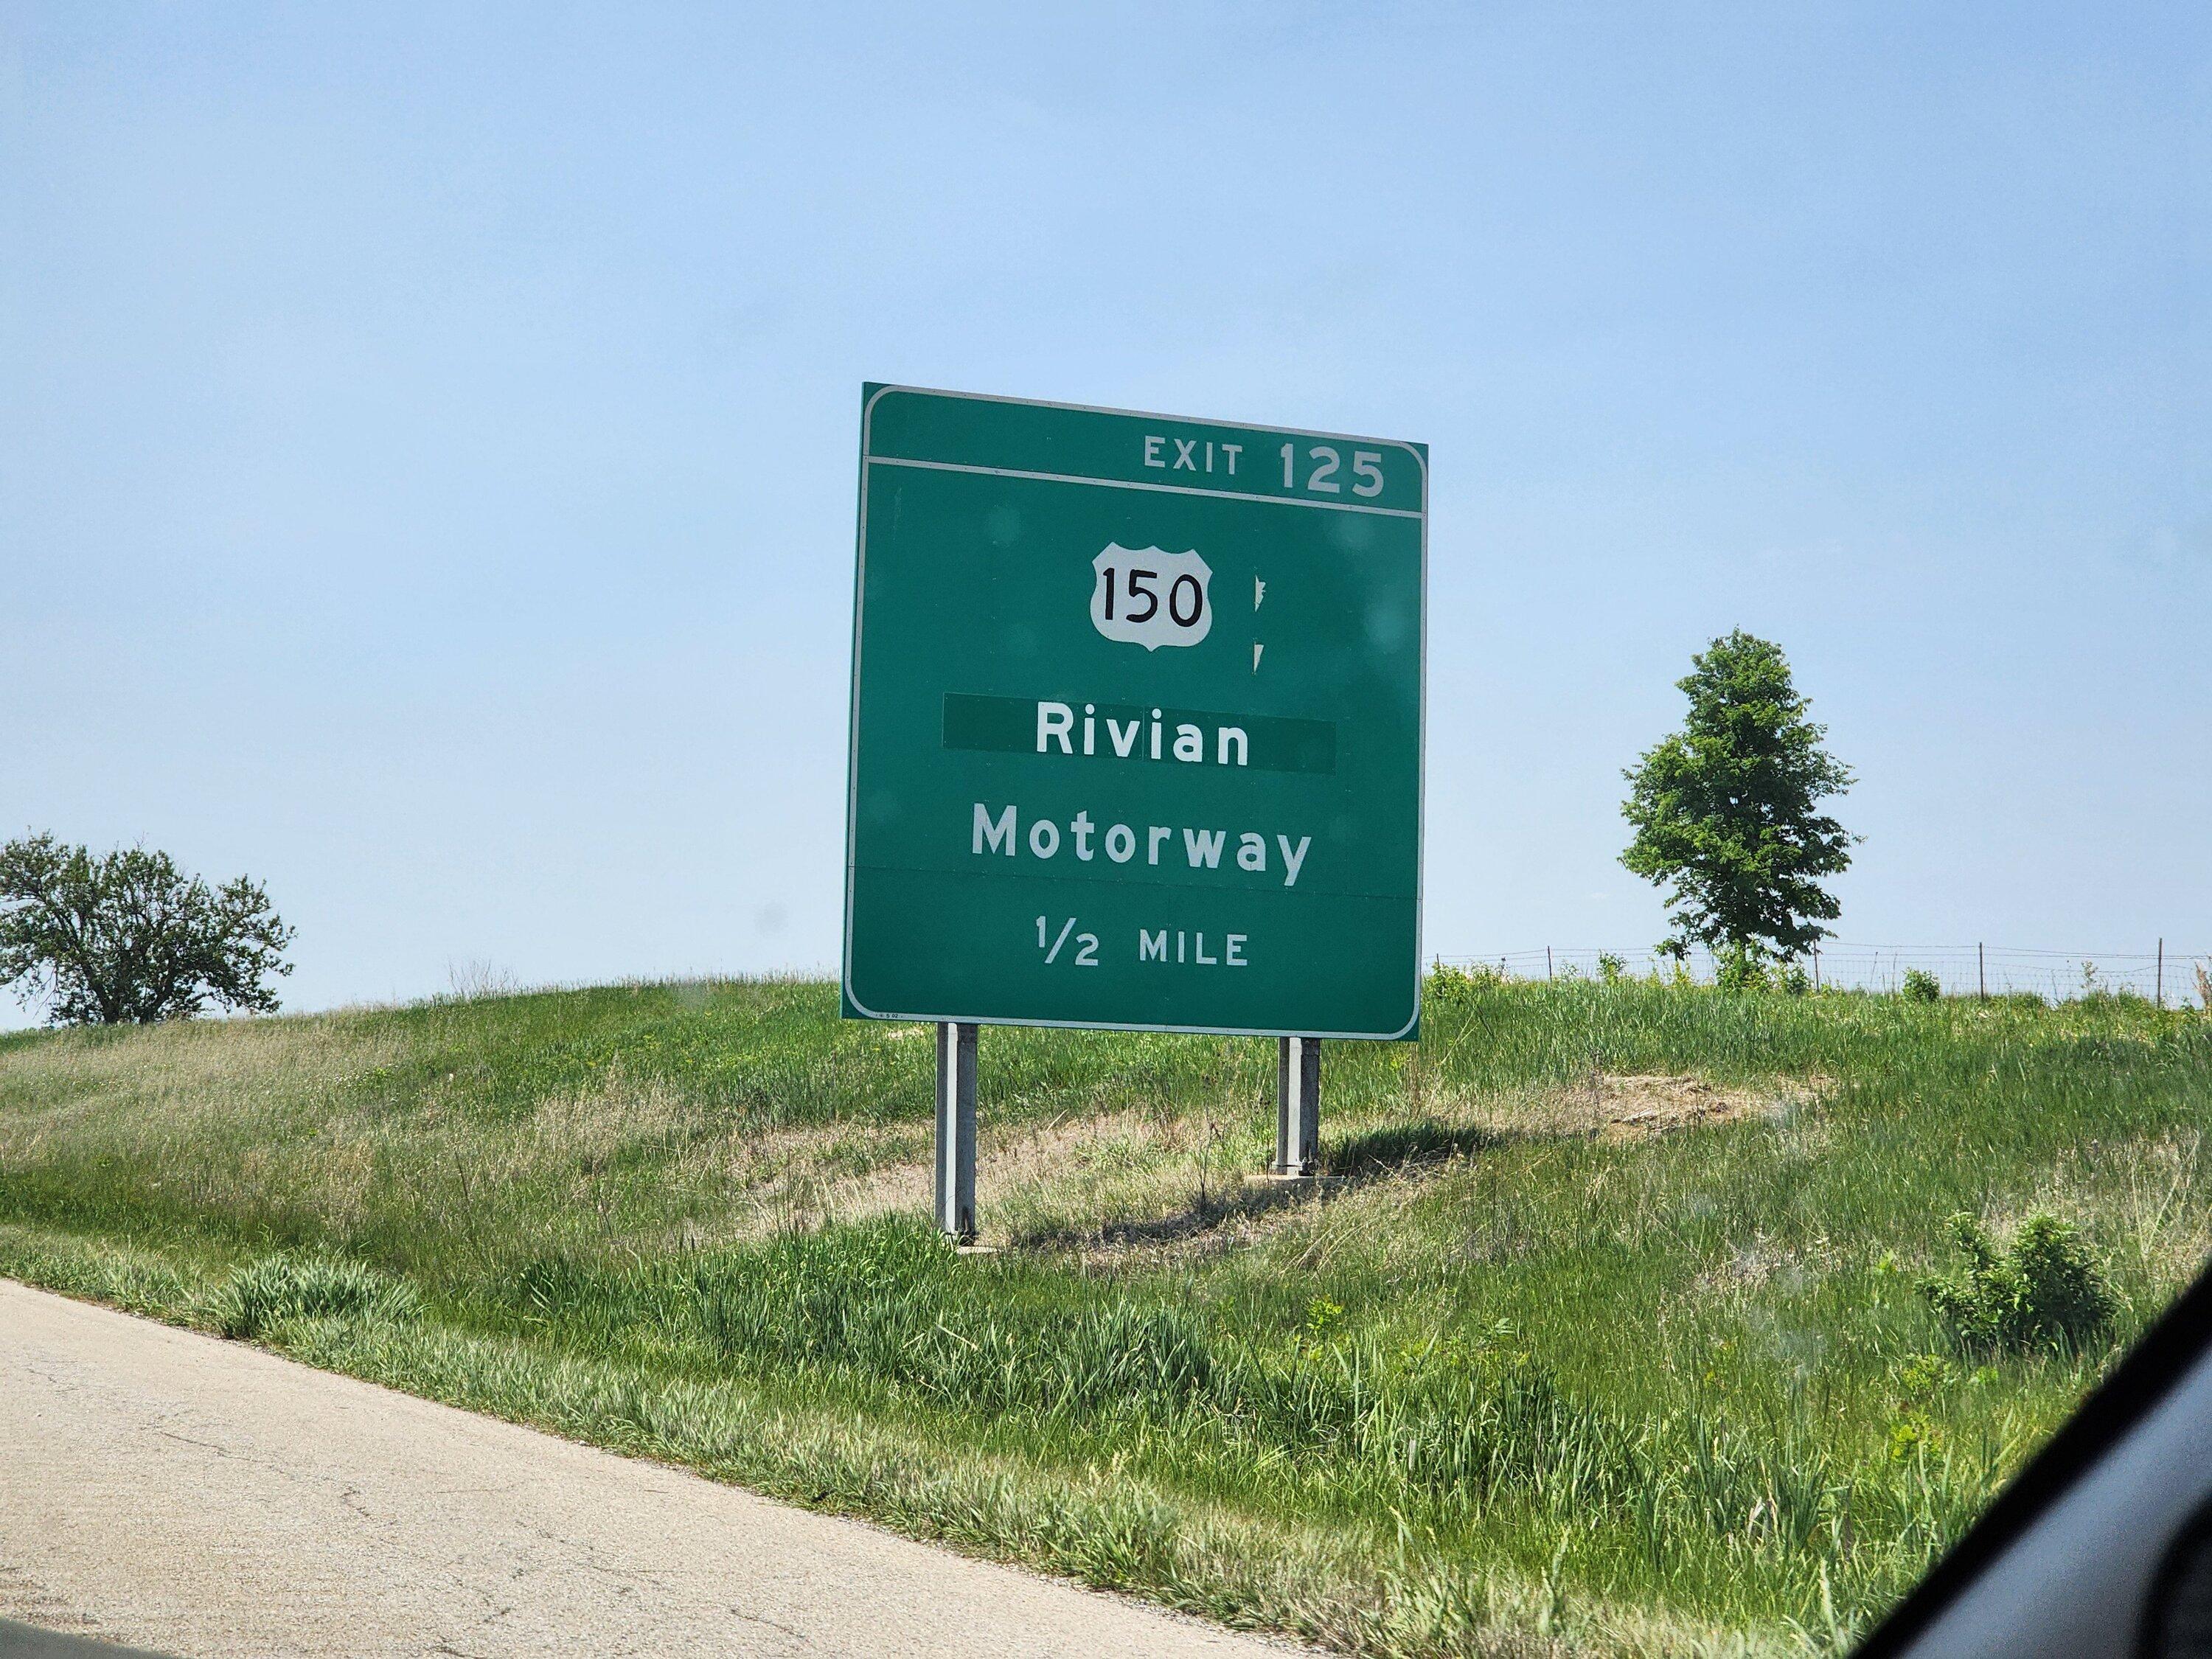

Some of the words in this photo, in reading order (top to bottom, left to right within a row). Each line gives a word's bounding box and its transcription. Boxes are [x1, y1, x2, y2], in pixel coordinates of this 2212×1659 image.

[1144, 436, 1242, 475] EXIT
[1281, 443, 1384, 497] 125
[1102, 567, 1203, 628] 150
[1037, 701, 1248, 766] Rivian
[972, 803, 1312, 886] Motorway
[1036, 916, 1099, 966] 1/2
[1139, 929, 1248, 966] MILE
